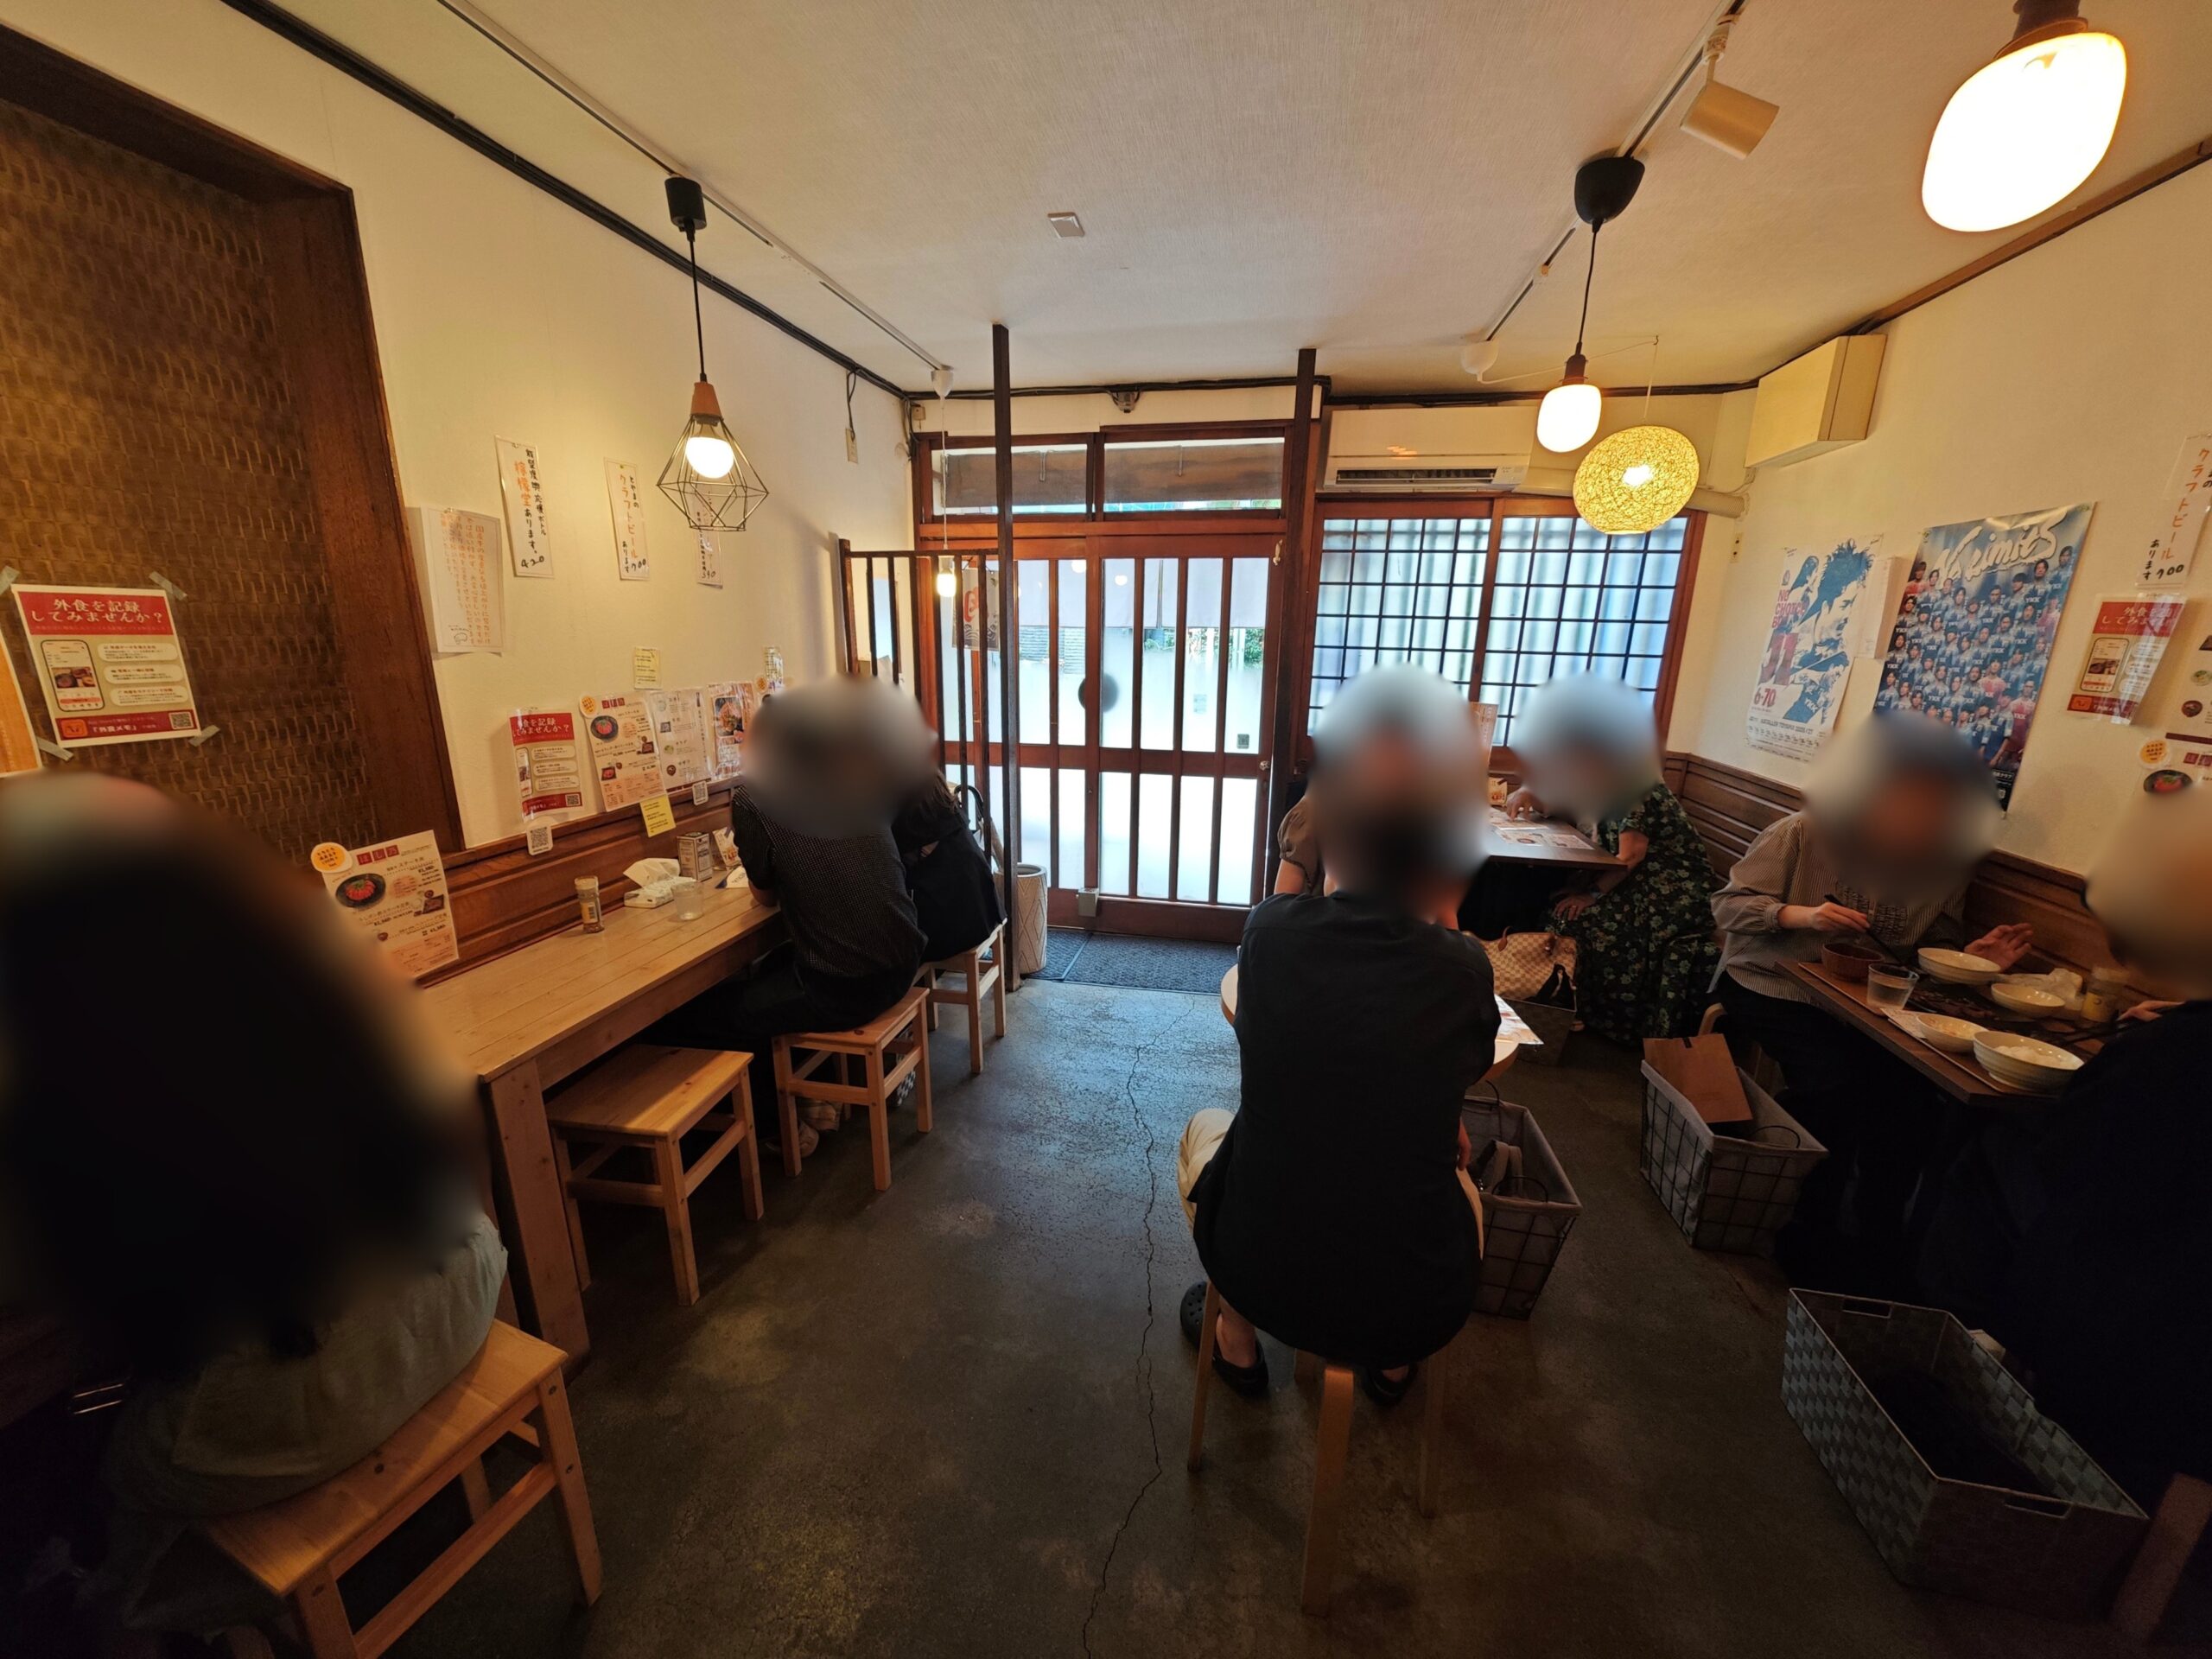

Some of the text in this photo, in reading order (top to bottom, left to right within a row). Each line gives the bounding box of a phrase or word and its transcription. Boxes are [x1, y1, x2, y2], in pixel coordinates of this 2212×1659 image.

[2161, 448, 2210, 561] クラフトビール
[620, 474, 639, 559] クラフトビール
[520, 555, 545, 569] 420
[631, 558, 646, 571] 700
[2143, 539, 2159, 581] あります
[2156, 563, 2184, 579] 700
[54, 598, 141, 613] 外食を記録
[30, 610, 164, 624] してみませんか？
